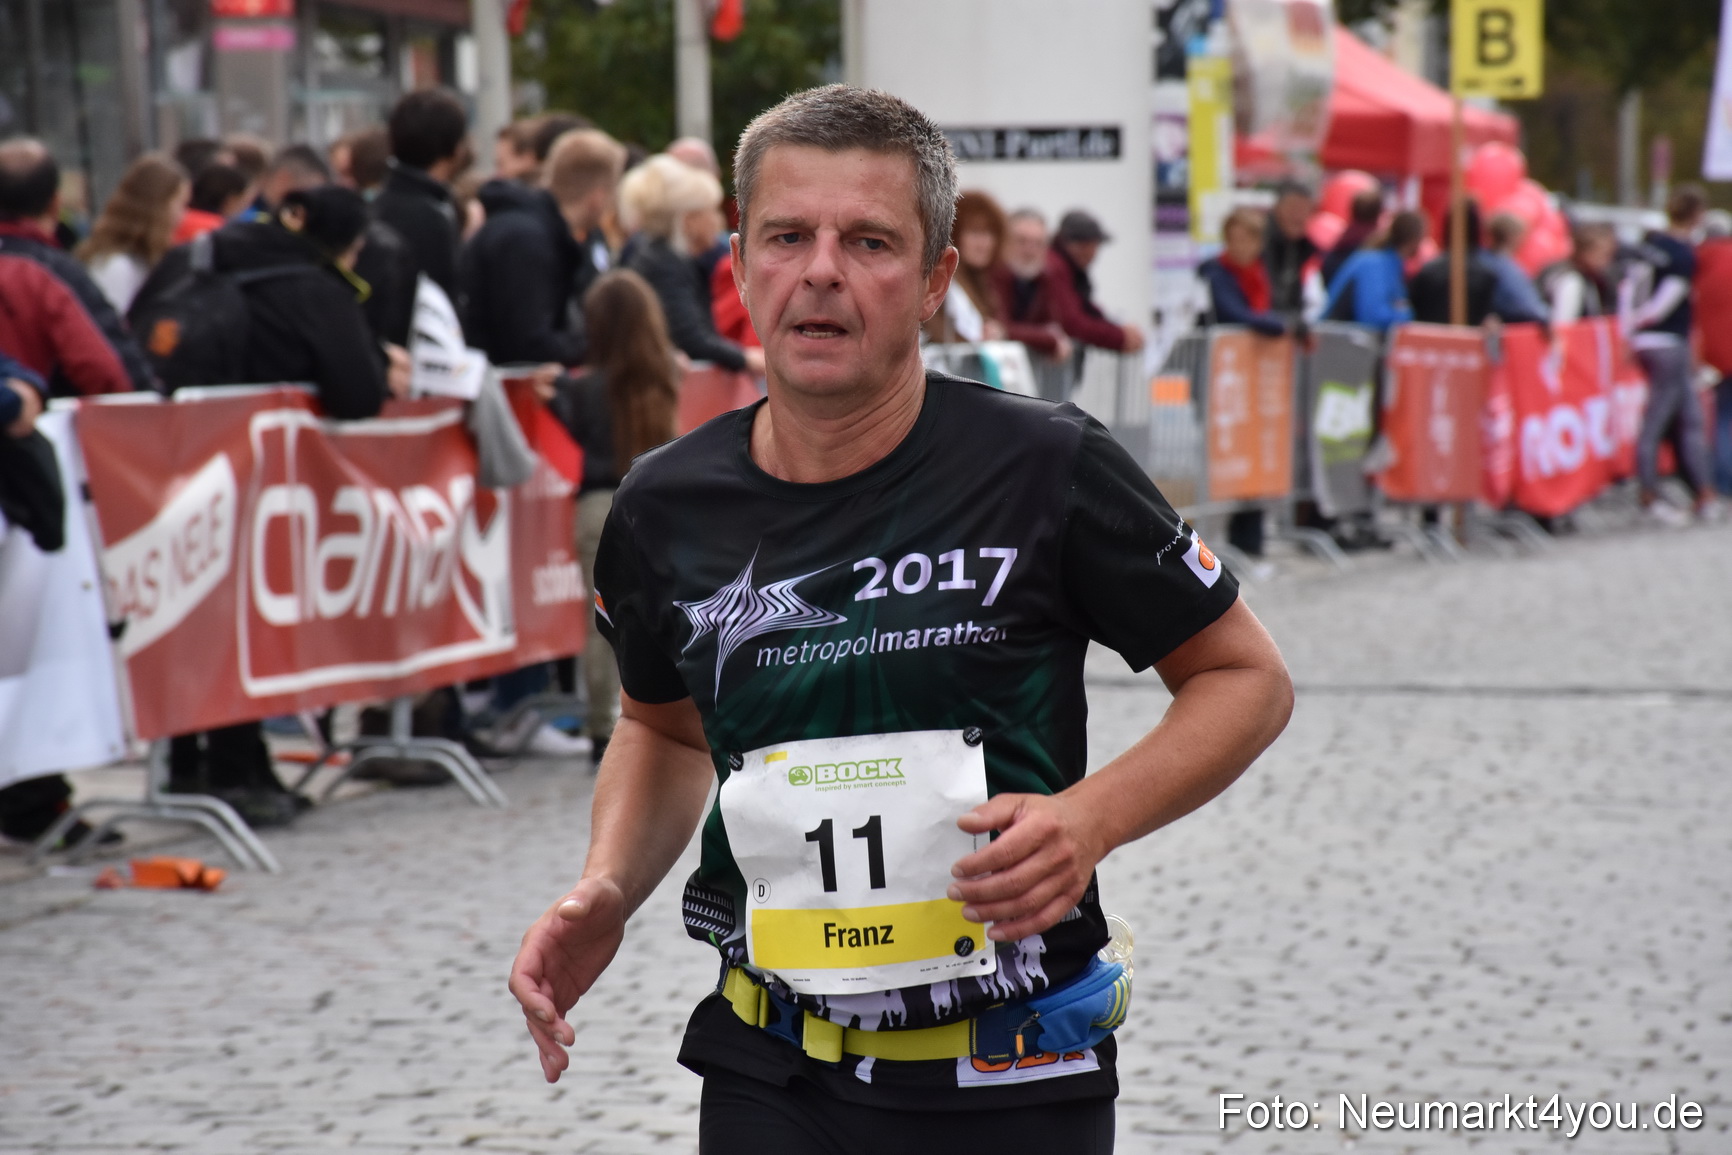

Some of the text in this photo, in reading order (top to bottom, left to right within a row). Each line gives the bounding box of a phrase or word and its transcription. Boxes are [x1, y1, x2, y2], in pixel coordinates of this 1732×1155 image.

[1477, 8, 1516, 67] B
[853, 547, 1018, 607] 2017
[756, 620, 1007, 667] metropolmarathon
[815, 758, 905, 785] BOCK
[815, 784, 842, 792] inspired
[843, 783, 852, 791] by
[875, 779, 906, 788] concepts
[804, 815, 886, 893] 11
[757, 884, 766, 898] D
[823, 922, 895, 948] Franz
